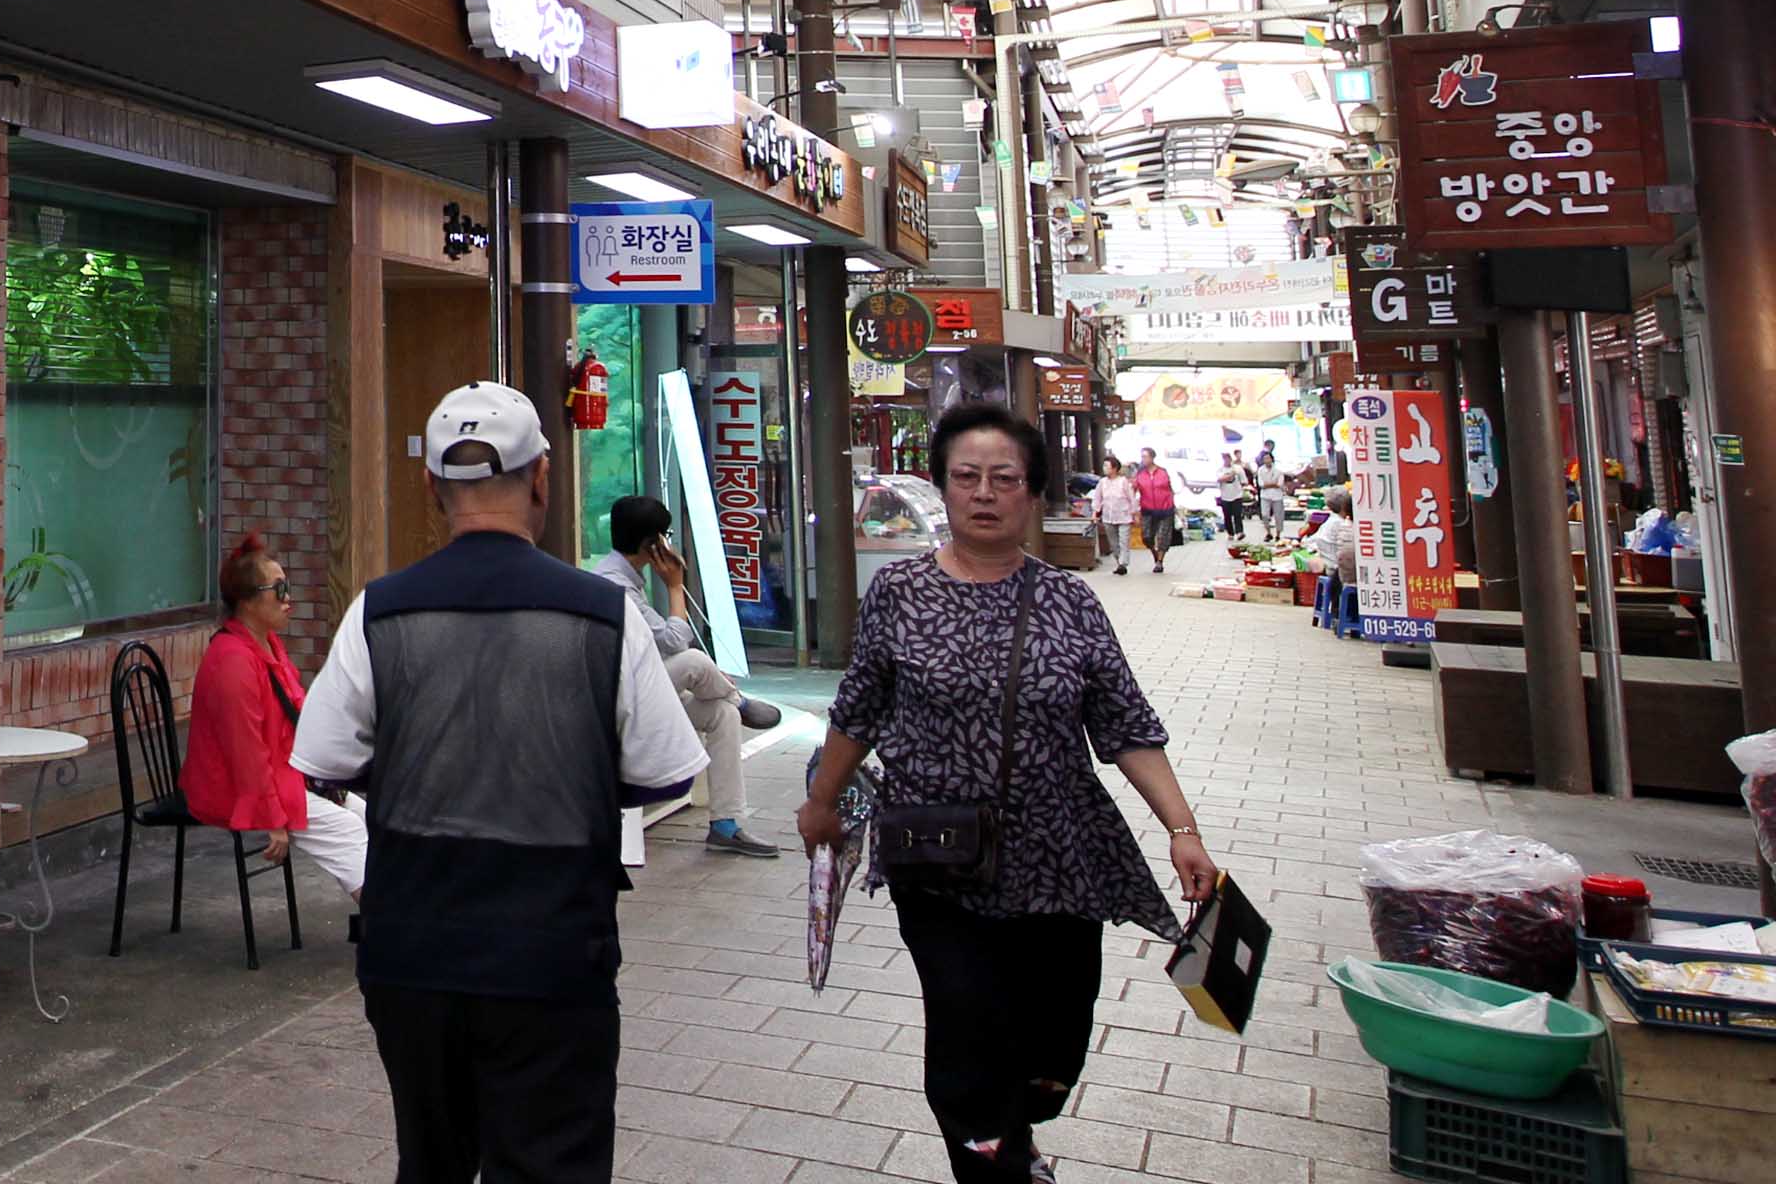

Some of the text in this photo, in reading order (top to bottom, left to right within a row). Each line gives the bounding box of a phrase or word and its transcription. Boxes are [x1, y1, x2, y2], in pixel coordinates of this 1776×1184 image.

[1495, 110, 1603, 160] 중앙
[1439, 170, 1616, 223] 방앗간
[620, 224, 694, 254] 화장실
[630, 255, 687, 266] Restroom
[855, 318, 879, 347] 수도
[1395, 344, 1440, 362] 기름
[1356, 397, 1382, 418] 즉석
[711, 376, 762, 603] 수도정육점
[1351, 424, 1375, 560] 참기름
[1374, 425, 1398, 562] 들기름
[1398, 402, 1444, 569] 고추
[1360, 589, 1403, 610] 미숫가루
